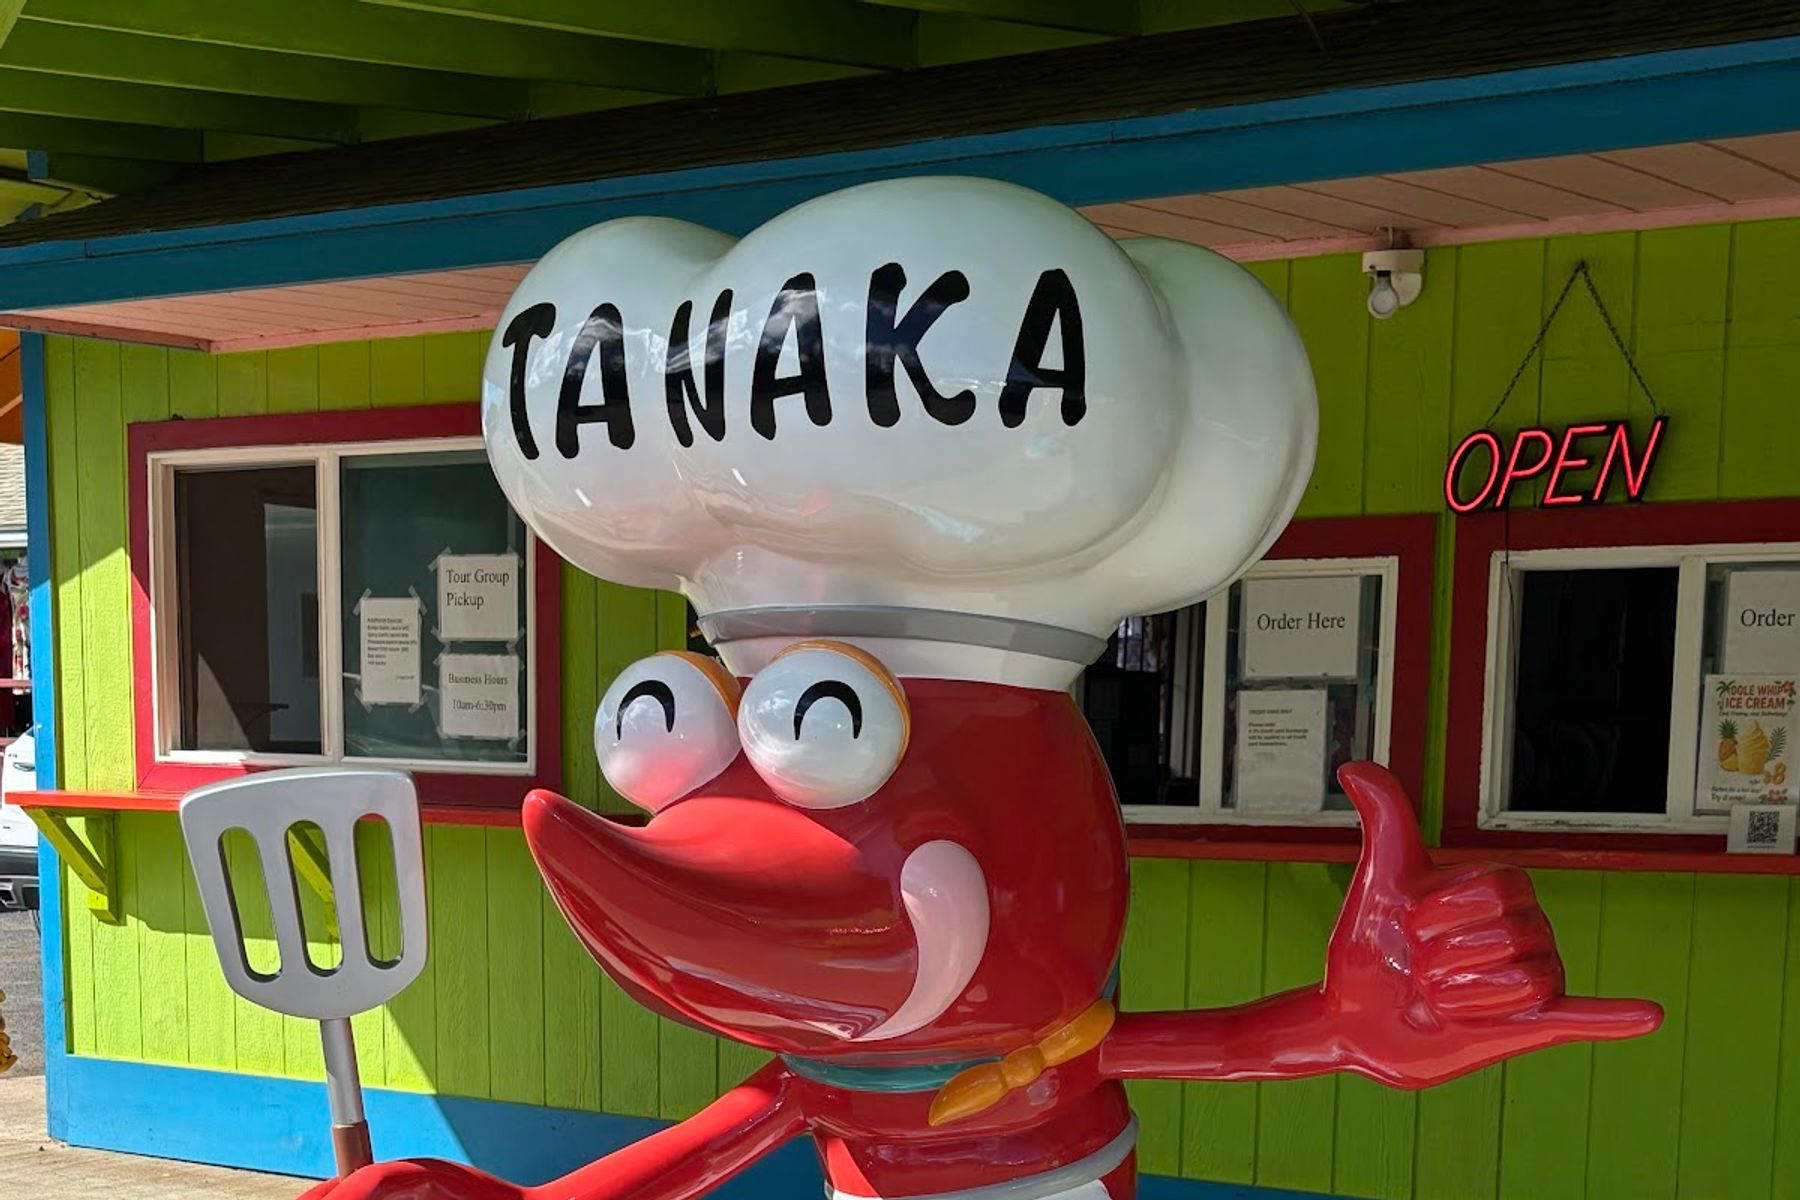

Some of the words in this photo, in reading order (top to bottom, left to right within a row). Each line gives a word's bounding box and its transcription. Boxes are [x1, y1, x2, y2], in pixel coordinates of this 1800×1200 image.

[502, 262, 1087, 460] TANAKA
[1444, 419, 1664, 513] OPEN
[446, 569, 472, 583] Tour
[474, 568, 510, 587] Group
[447, 592, 484, 610] Pickup
[1257, 613, 1303, 631] Order
[1307, 612, 1345, 629] Here
[1741, 608, 1796, 627] Order
[448, 672, 482, 684] Business
[484, 673, 508, 685] Hours
[1731, 684, 1755, 696] DOLE
[1757, 684, 1783, 696] WHIP
[1725, 697, 1743, 709] ICE
[1745, 697, 1785, 709] CREAM
